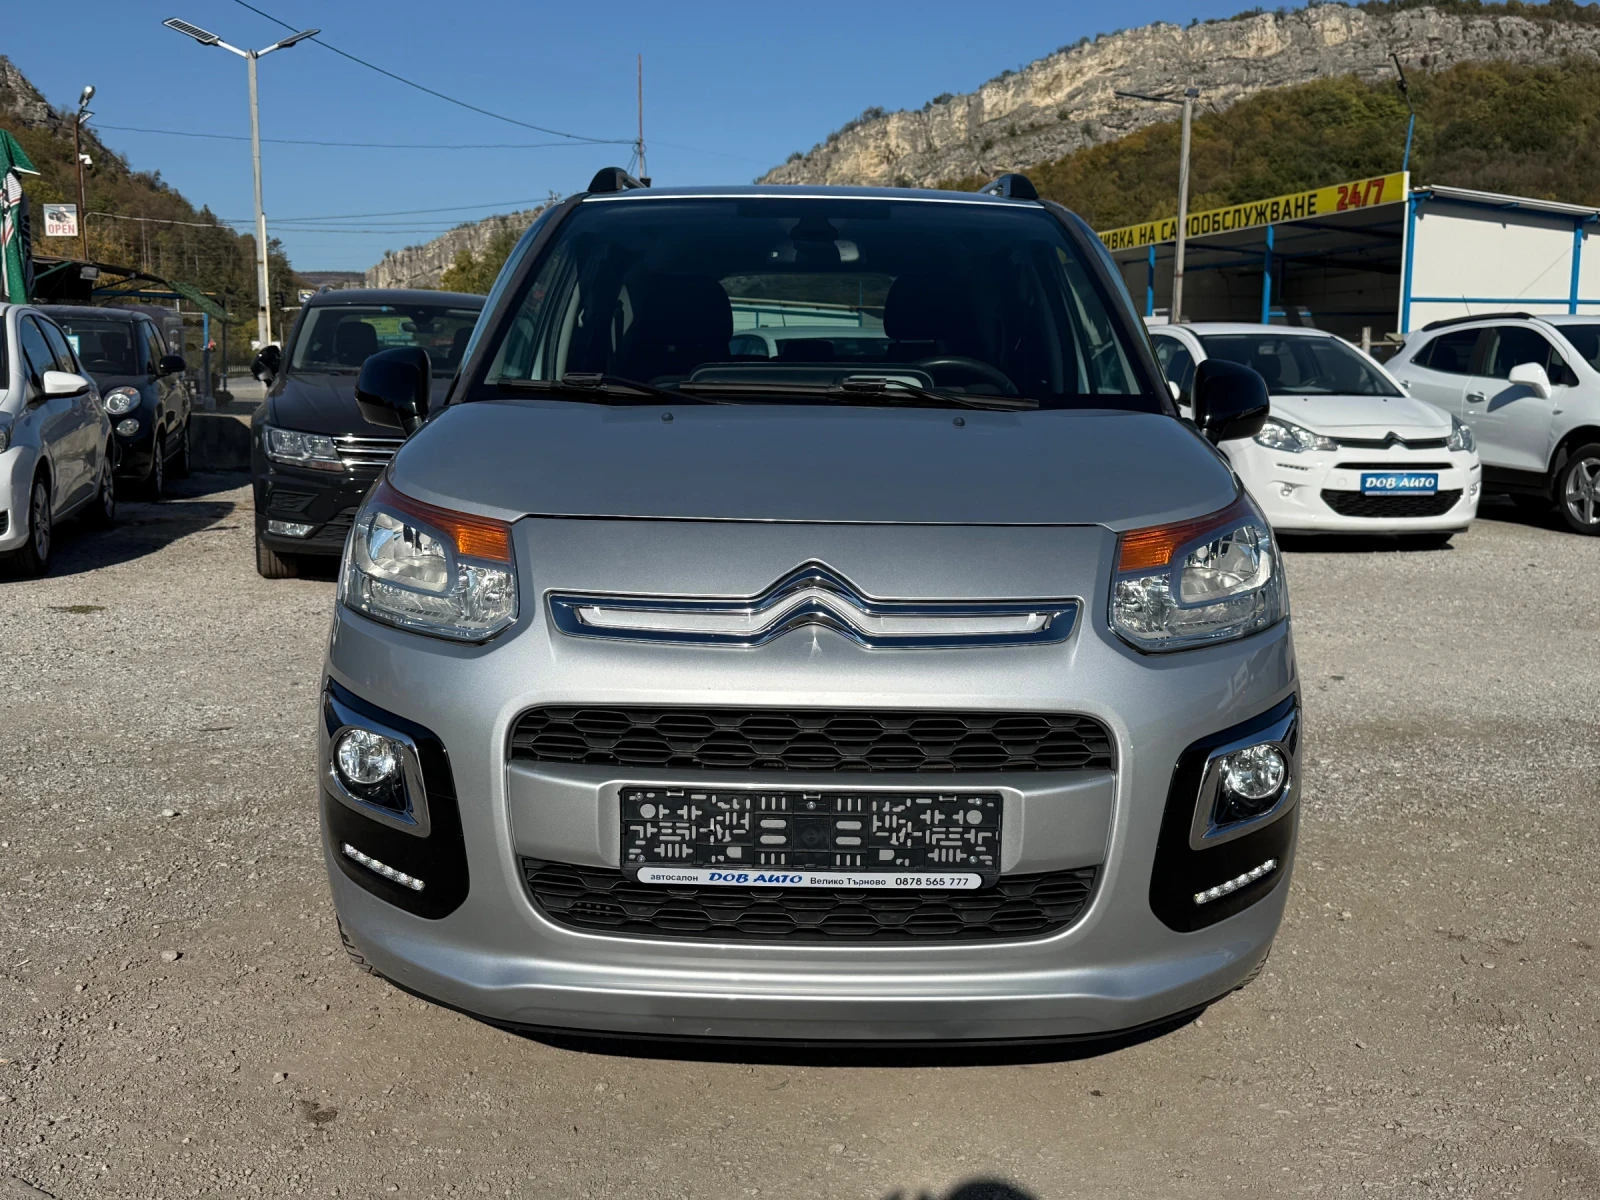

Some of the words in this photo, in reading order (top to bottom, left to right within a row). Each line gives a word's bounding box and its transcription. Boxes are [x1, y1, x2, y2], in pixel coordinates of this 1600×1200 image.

[1100, 230, 1134, 250] ИВКА
[1139, 225, 1156, 245] НА
[1336, 178, 1385, 212] 24/7
[48, 223, 75, 234] OPEN
[1365, 477, 1396, 489] DOB
[1399, 477, 1435, 488] AUTO
[650, 873, 699, 882] автосалон
[708, 872, 749, 884] DOB
[753, 874, 803, 884] AUTO
[810, 877, 844, 885] Велико
[847, 877, 887, 886] Търново
[895, 877, 922, 886] 0878
[925, 877, 946, 886] 565
[949, 877, 969, 886] 777
